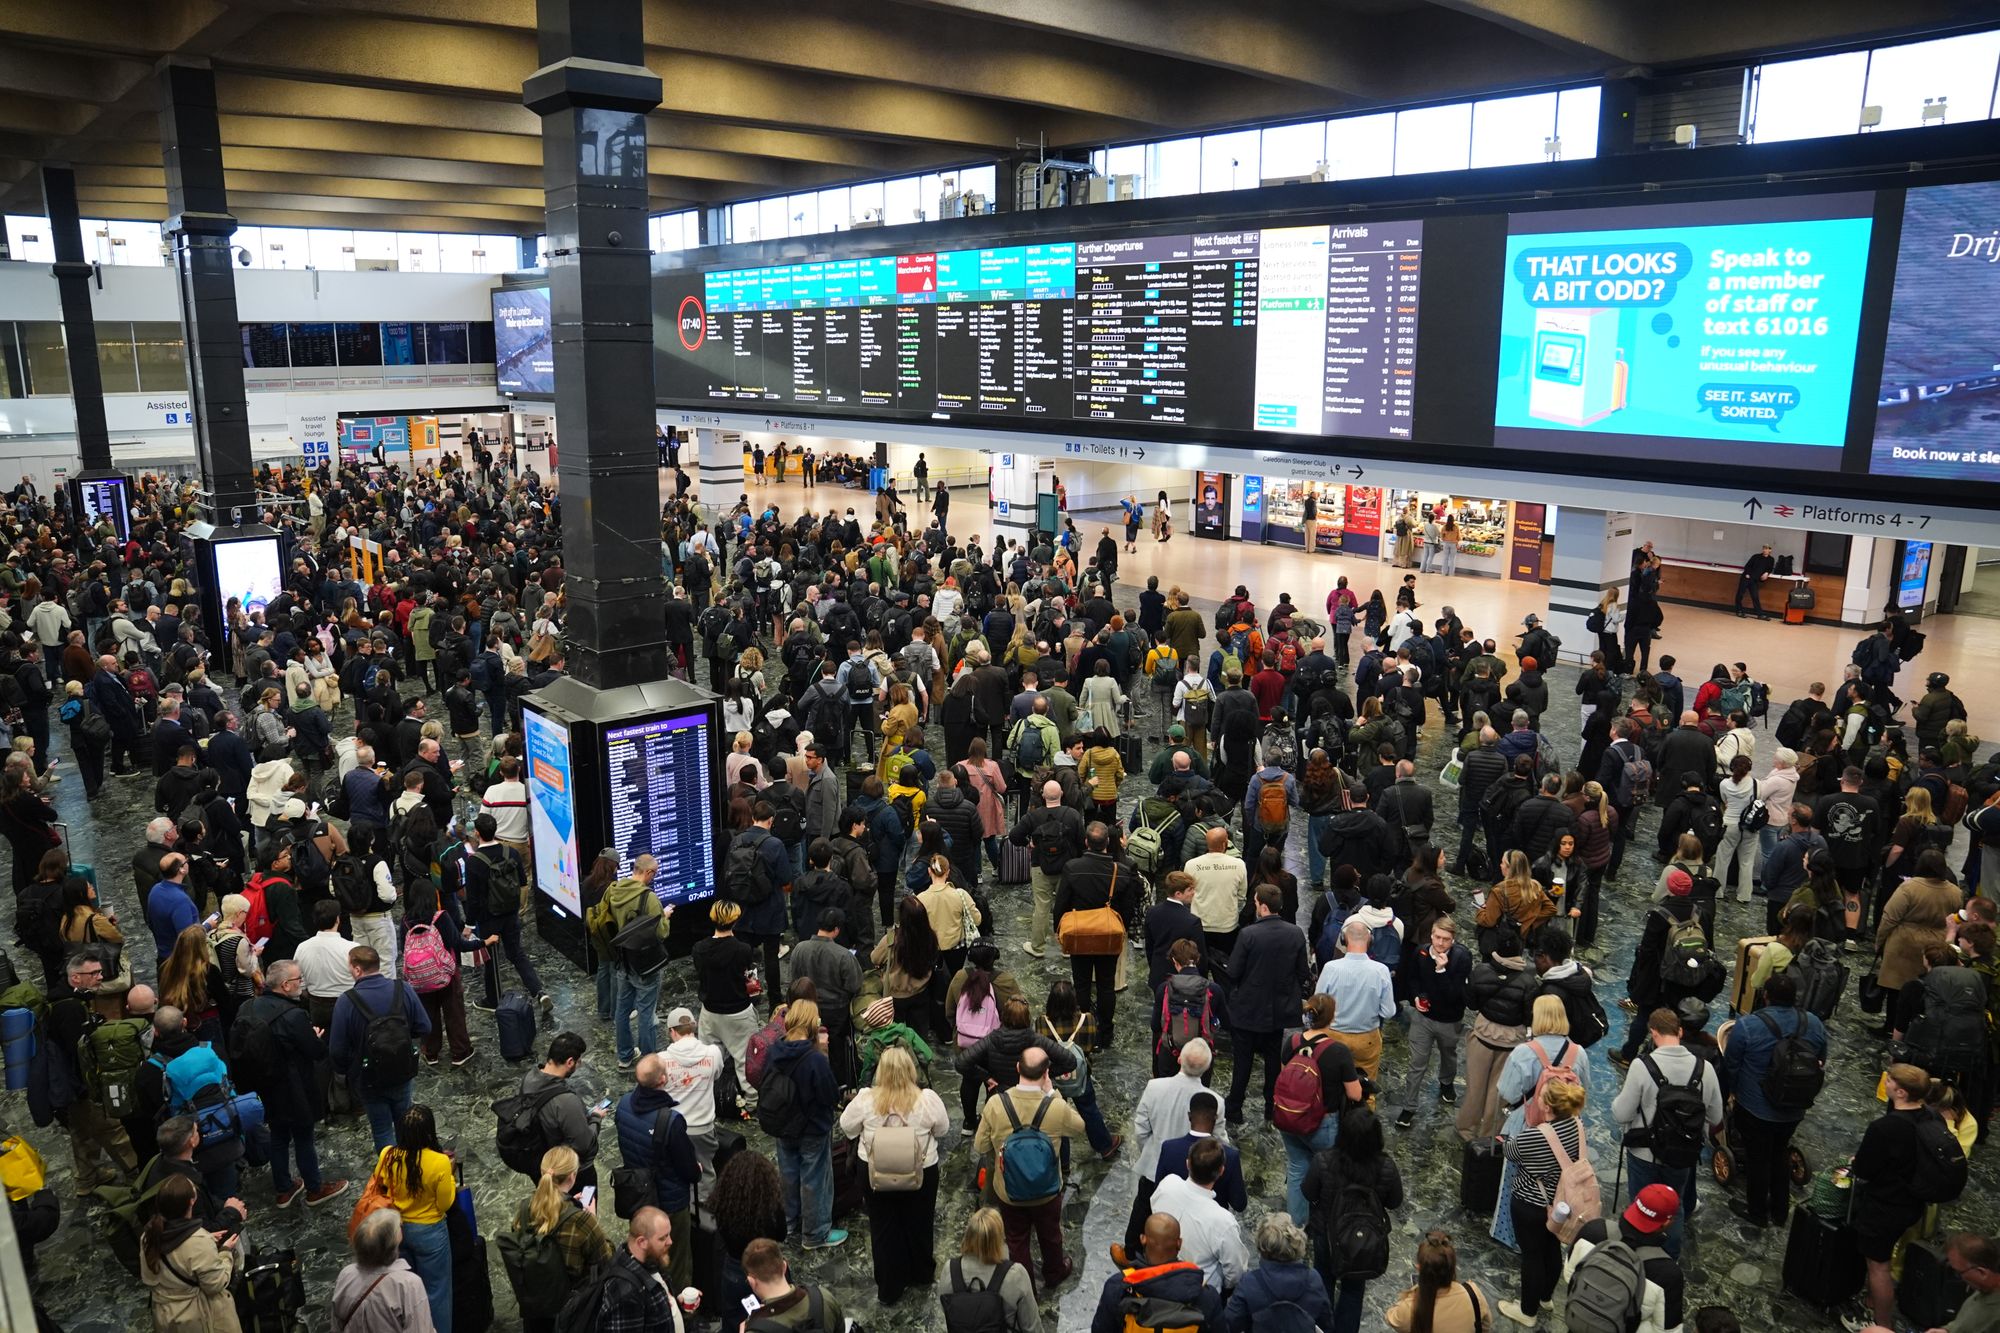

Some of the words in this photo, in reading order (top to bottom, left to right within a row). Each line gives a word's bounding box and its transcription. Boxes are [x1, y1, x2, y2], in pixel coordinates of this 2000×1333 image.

[1332, 227, 1368, 238] Arrivals
[1194, 236, 1212, 247] Next
[1214, 235, 1242, 245] fastest
[1078, 244, 1103, 254] Further
[1105, 242, 1143, 253] Departures
[1527, 256, 1588, 276] THAT
[1592, 252, 1676, 275] LOOKS
[1710, 248, 1780, 272] Speak
[1784, 248, 1811, 266] to
[1707, 276, 1720, 290] a
[1725, 270, 1824, 290] member
[1533, 282, 1549, 301] A
[1554, 281, 1591, 300] BIT
[1595, 279, 1665, 300] ODD?
[1705, 294, 1732, 313] of
[1732, 292, 1790, 312] staff
[1791, 298, 1818, 312] or
[682, 318, 700, 330] 07:40
[1704, 317, 1750, 335] text
[1755, 316, 1828, 335] 61016
[1701, 345, 1711, 356] If
[1711, 348, 1735, 360] you
[1738, 348, 1760, 357] see
[1762, 348, 1786, 360] any
[1700, 361, 1748, 372] unusual
[1750, 361, 1818, 373] behaviour
[1705, 390, 1729, 401] SEE
[1730, 390, 1746, 402] IT.
[1750, 392, 1776, 403] SAY
[1778, 393, 1794, 404] IT.
[147, 402, 187, 410] Assisted
[1721, 406, 1778, 419] SORTED.
[781, 421, 802, 430] Platforms
[1090, 443, 1115, 455] Toilets
[1893, 447, 1926, 460] Book
[1929, 450, 1960, 461] now
[1962, 451, 1976, 462] at
[1263, 456, 1291, 465] Caledonian
[1292, 458, 1313, 467] Sleeper
[1307, 469, 1326, 477] lounge
[1802, 505, 1885, 526] Platforms
[1890, 514, 1902, 527] 4
[1920, 516, 1932, 530] 7
[624, 728, 644, 737] fastest
[689, 891, 707, 901] 07:40
